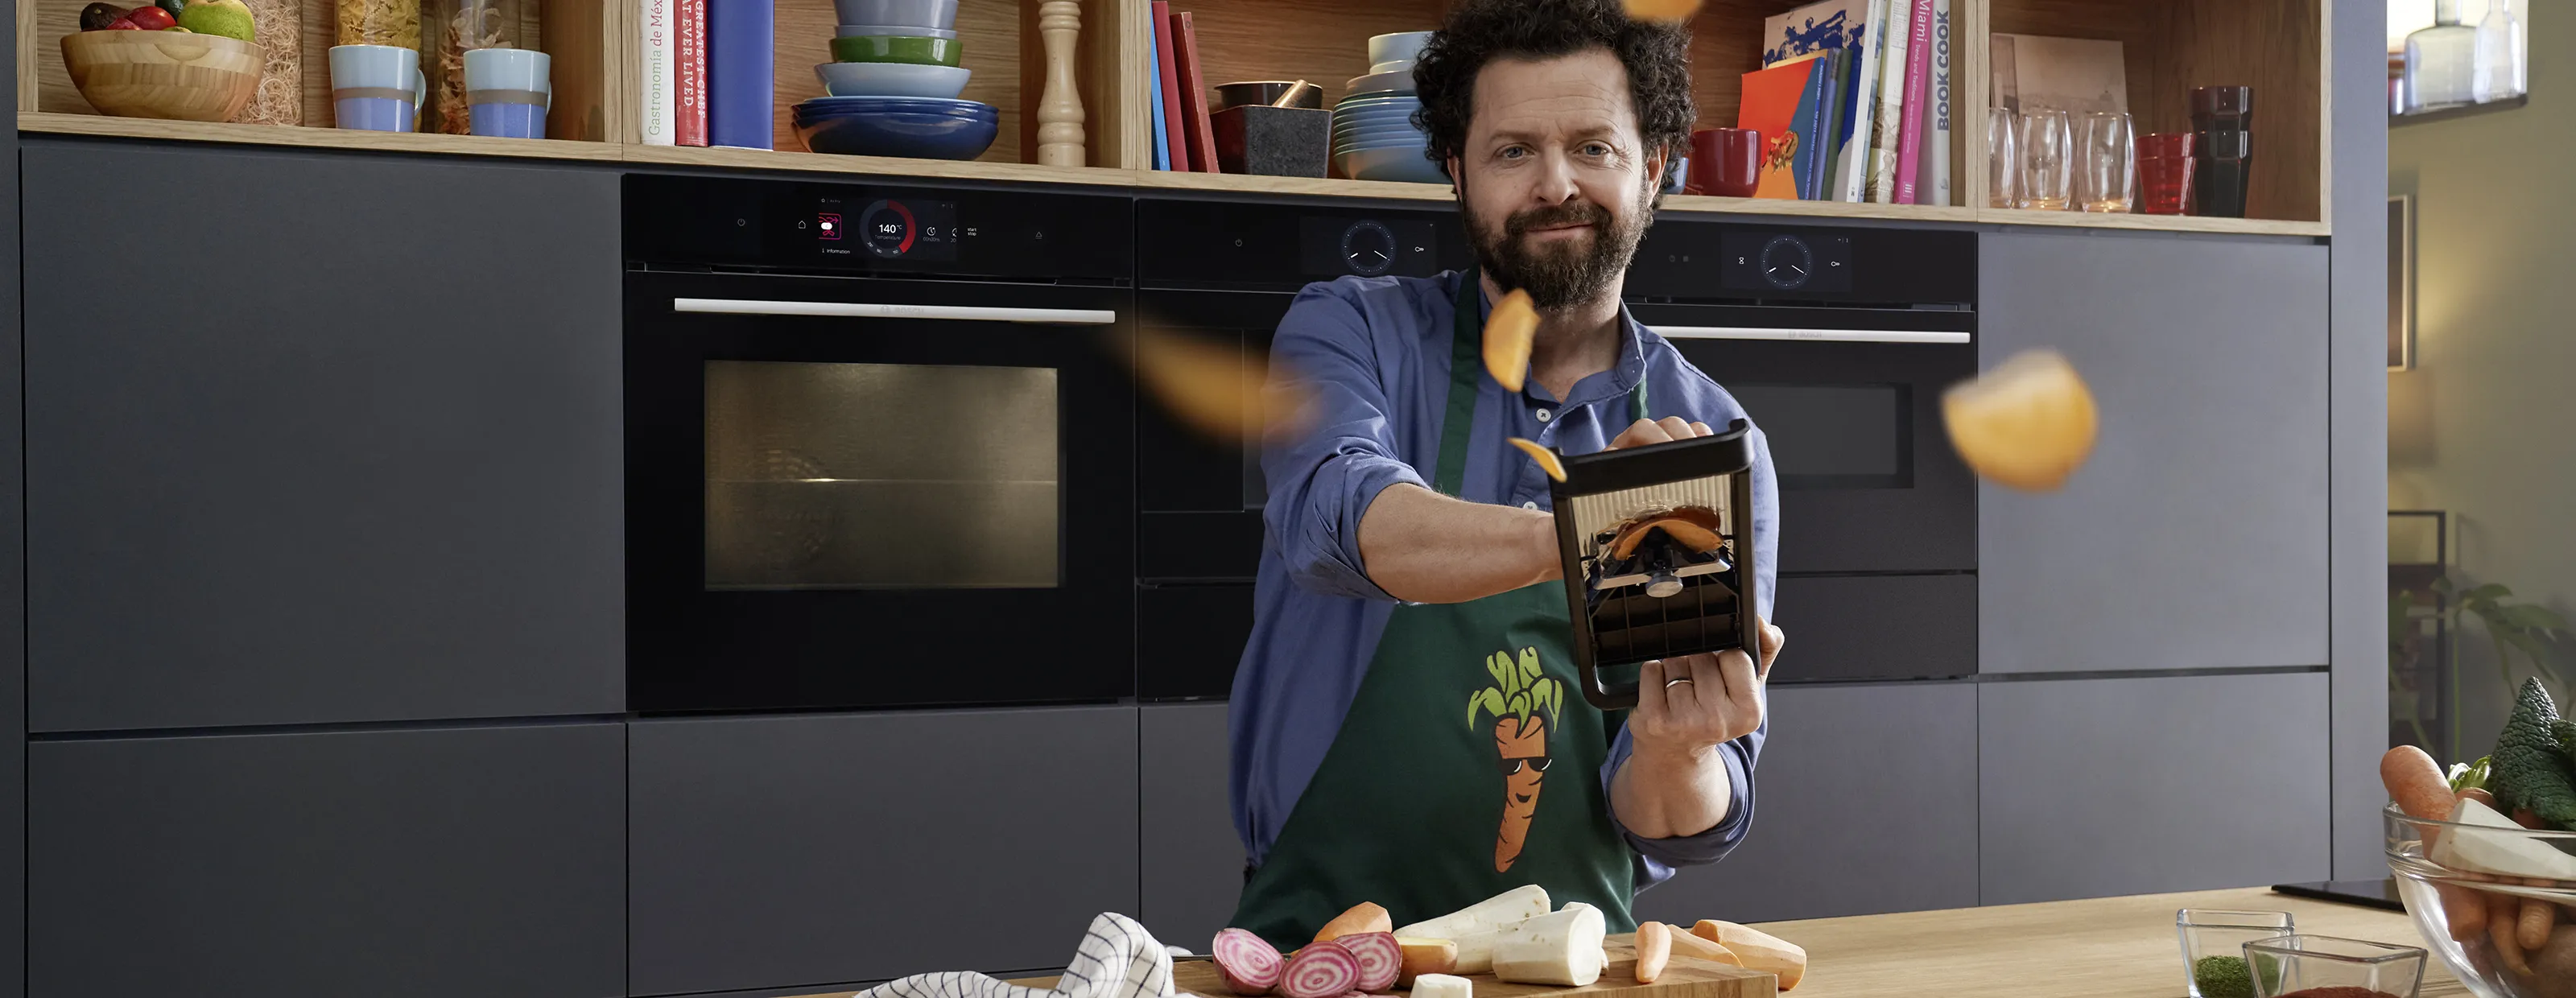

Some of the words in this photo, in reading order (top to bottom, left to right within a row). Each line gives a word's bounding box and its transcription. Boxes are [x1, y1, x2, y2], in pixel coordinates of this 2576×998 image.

[650, 31, 662, 47] de
[682, 19, 692, 56] EVER
[695, 1, 704, 74] GREATEST
[1916, 0, 1931, 43] Miami
[1936, 10, 1949, 68] COOK
[1913, 44, 1921, 62] Trends
[648, 50, 662, 136] Gastronomía
[683, 62, 694, 107] LIVED
[696, 80, 706, 118] CHEF
[1937, 72, 1950, 130] BOOK
